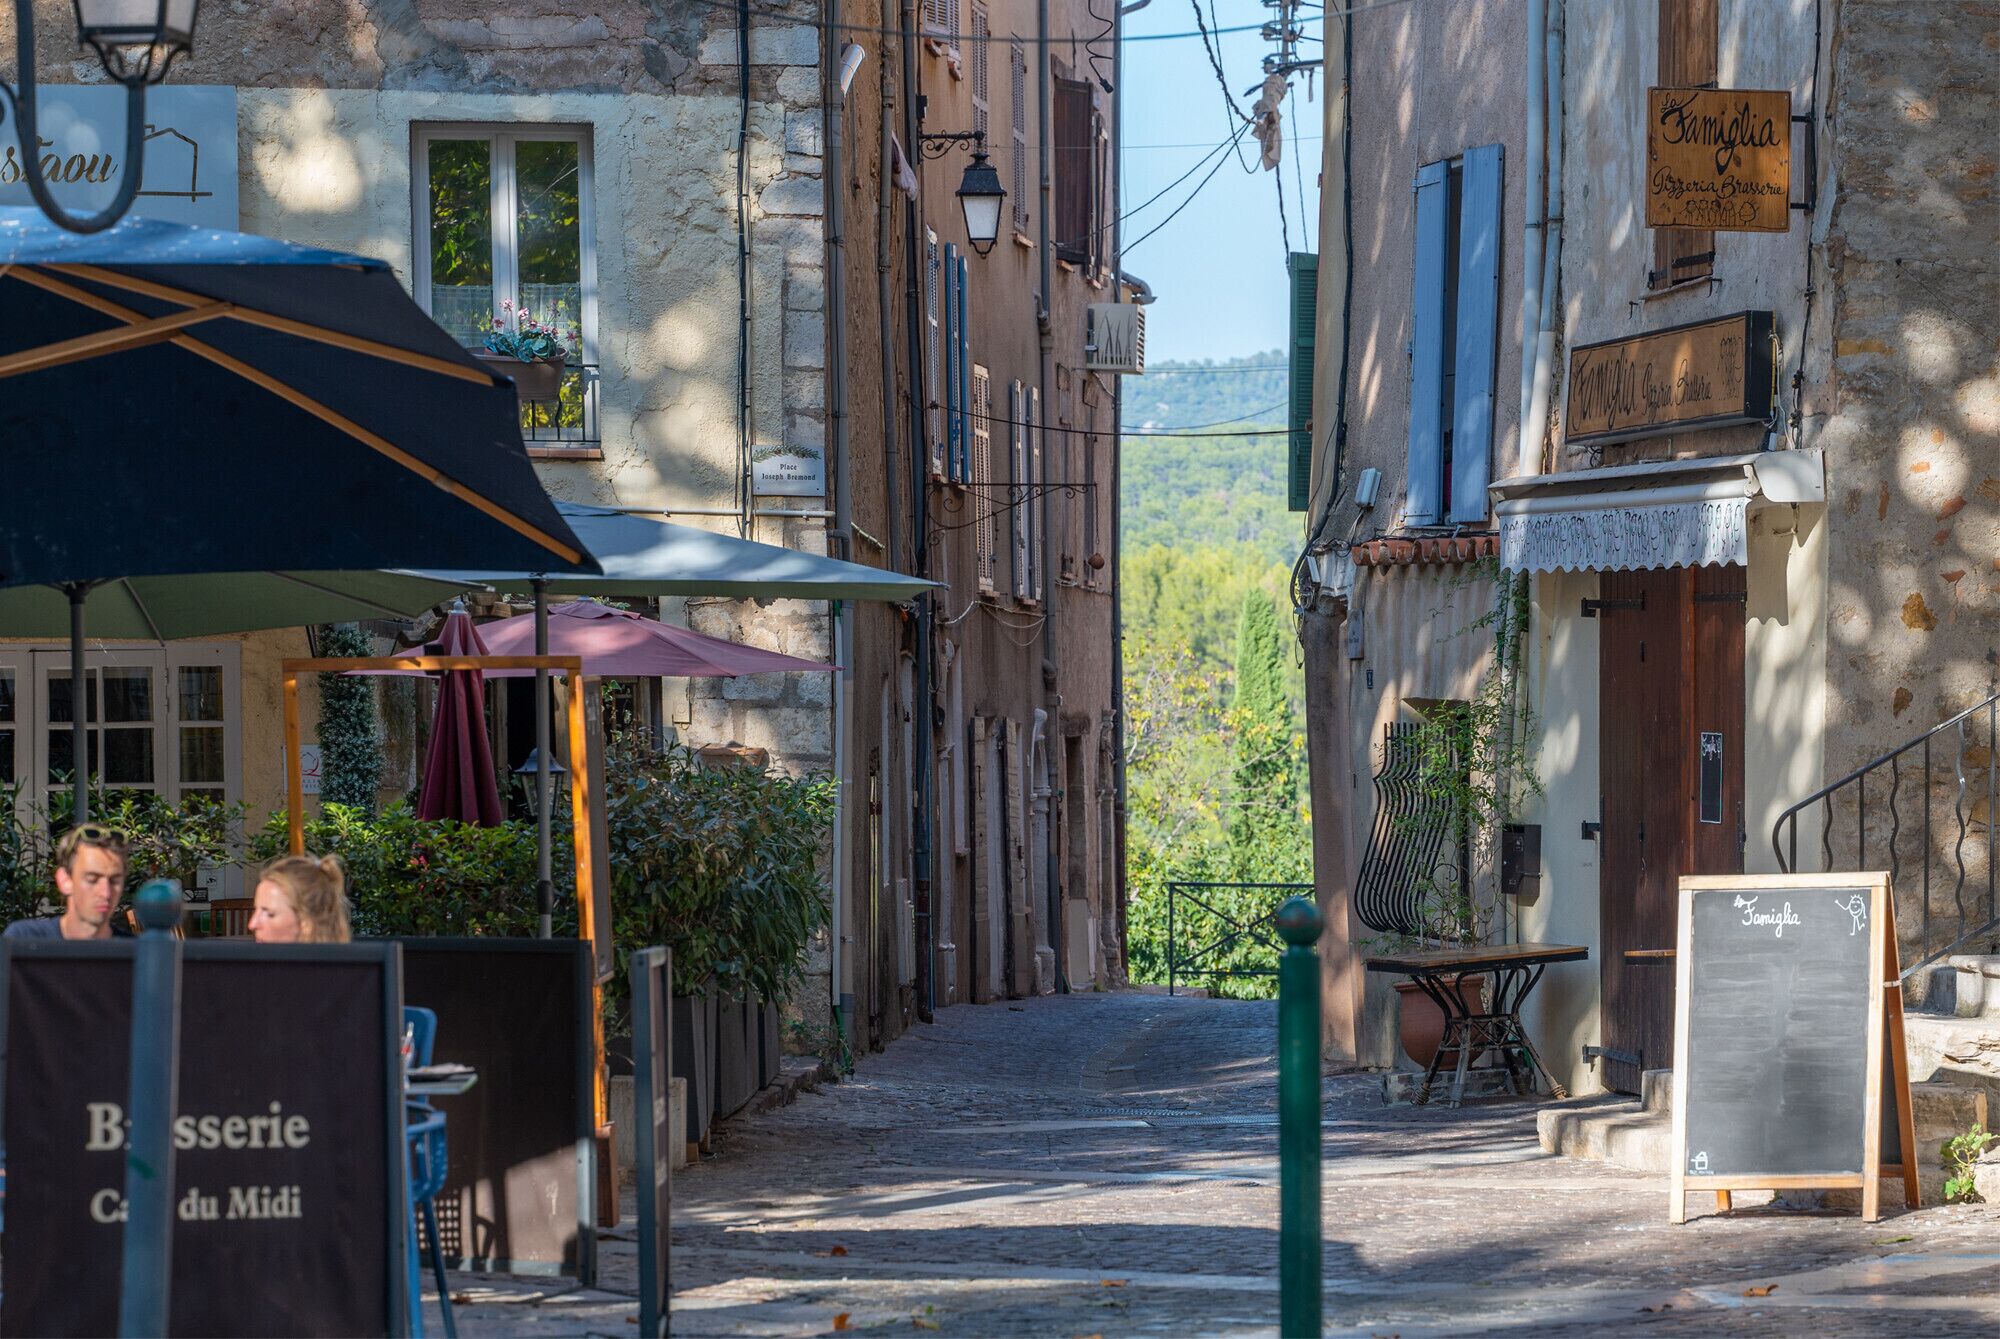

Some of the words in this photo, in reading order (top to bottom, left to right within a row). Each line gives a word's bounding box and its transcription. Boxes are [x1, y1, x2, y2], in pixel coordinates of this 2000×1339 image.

[1660, 93, 1781, 176] Famiglia
[1652, 166, 1718, 199] Pizzeria
[1716, 175, 1785, 199] Brasserie
[1572, 346, 1637, 431] Famiglia
[761, 473, 784, 481] Joseph
[787, 473, 816, 481] Bremond
[1742, 895, 1802, 938] Famiglia
[85, 1100, 311, 1151] Bsserie
[177, 1187, 220, 1221] du
[226, 1185, 303, 1219] Midi
